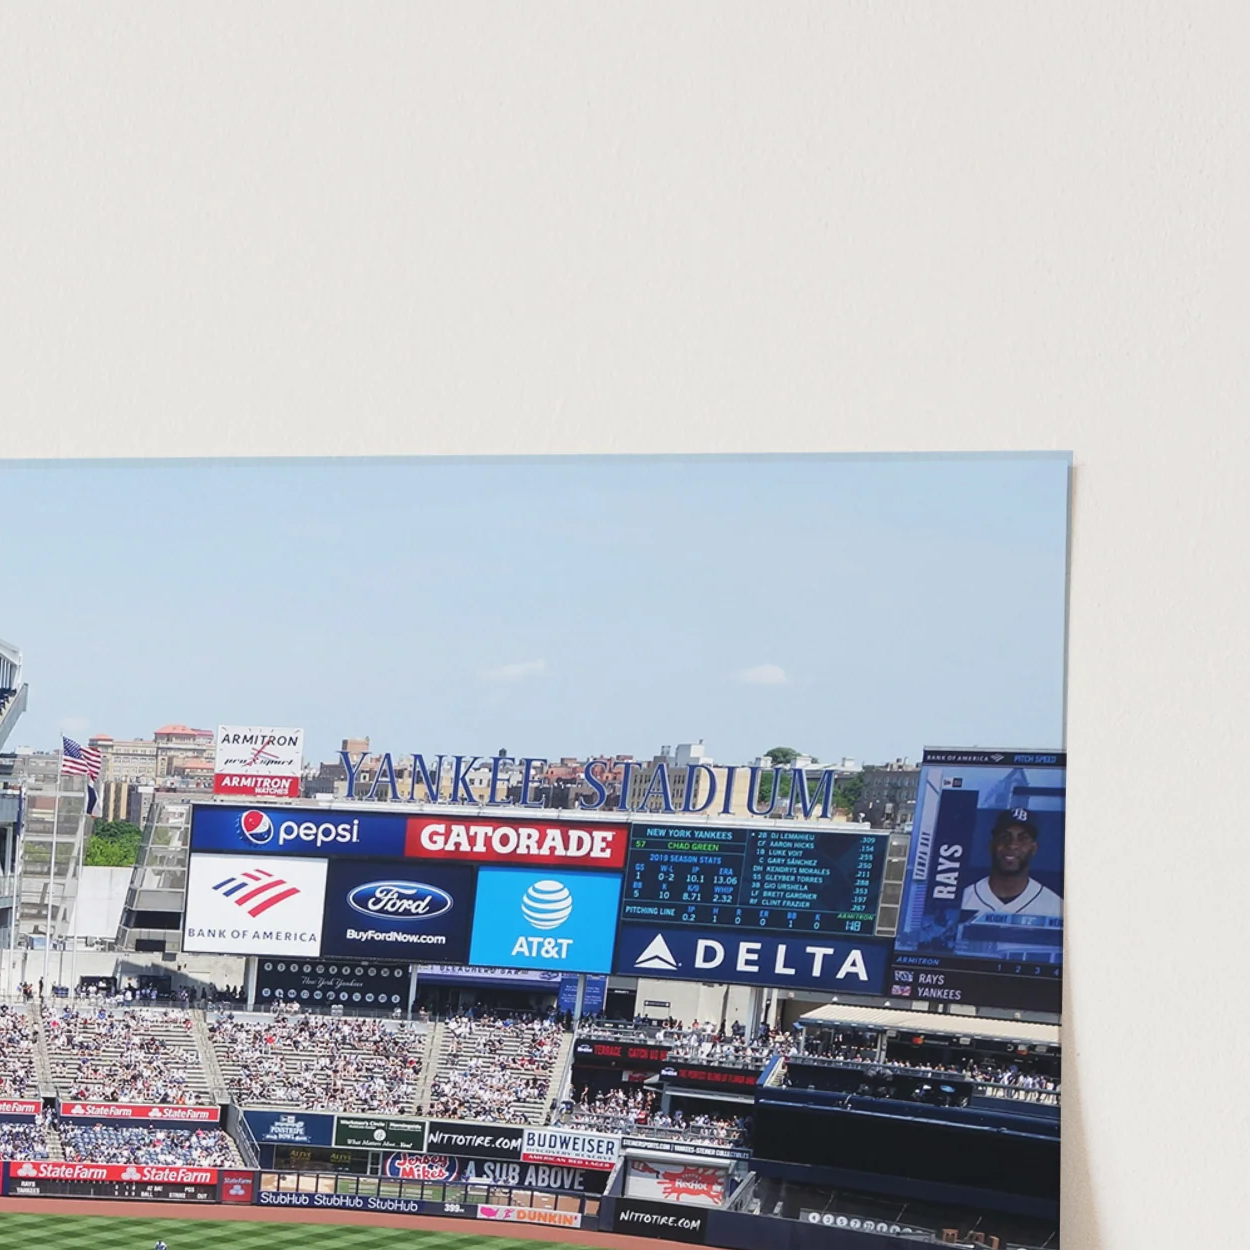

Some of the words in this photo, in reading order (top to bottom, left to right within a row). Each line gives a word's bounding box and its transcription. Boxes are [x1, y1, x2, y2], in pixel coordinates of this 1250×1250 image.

[221, 733, 298, 746] ARMITRON
[222, 776, 292, 788] ARMITRON
[336, 751, 548, 807] YANKEE
[579, 760, 838, 819] STADIUM
[278, 819, 358, 847] pepsi
[420, 824, 613, 858] GATORADE
[646, 828, 666, 836] NEW
[668, 829, 692, 838] YORK
[694, 830, 733, 840] YANKEES
[668, 842, 690, 850] CHAD
[691, 843, 720, 852] GREEN
[713, 876, 738, 884] 13.06
[933, 844, 963, 900] RAYS
[367, 886, 430, 915] Ford
[188, 928, 226, 940] BANK
[230, 929, 248, 940] OF
[252, 930, 318, 944] AMERICA
[346, 929, 446, 946] BuyFordNow.com
[511, 936, 573, 959] AT&T
[694, 937, 869, 982] DELTA
[918, 974, 945, 986] RAYS
[918, 987, 962, 1000] YANKEES
[428, 1130, 522, 1152] NITTOTIRE.COM
[527, 1132, 615, 1155] BUDWEISER
[396, 1152, 449, 1168] Jersey
[400, 1164, 448, 1180] Mike's
[483, 1161, 520, 1185] SUB
[525, 1164, 586, 1191] ABOVE
[260, 1192, 310, 1205] StubHub
[314, 1194, 364, 1208] StubHub
[367, 1197, 418, 1212] StubHub
[516, 1210, 578, 1226] DUNKIN'
[620, 1210, 702, 1232] NITTOTIRE.COM
